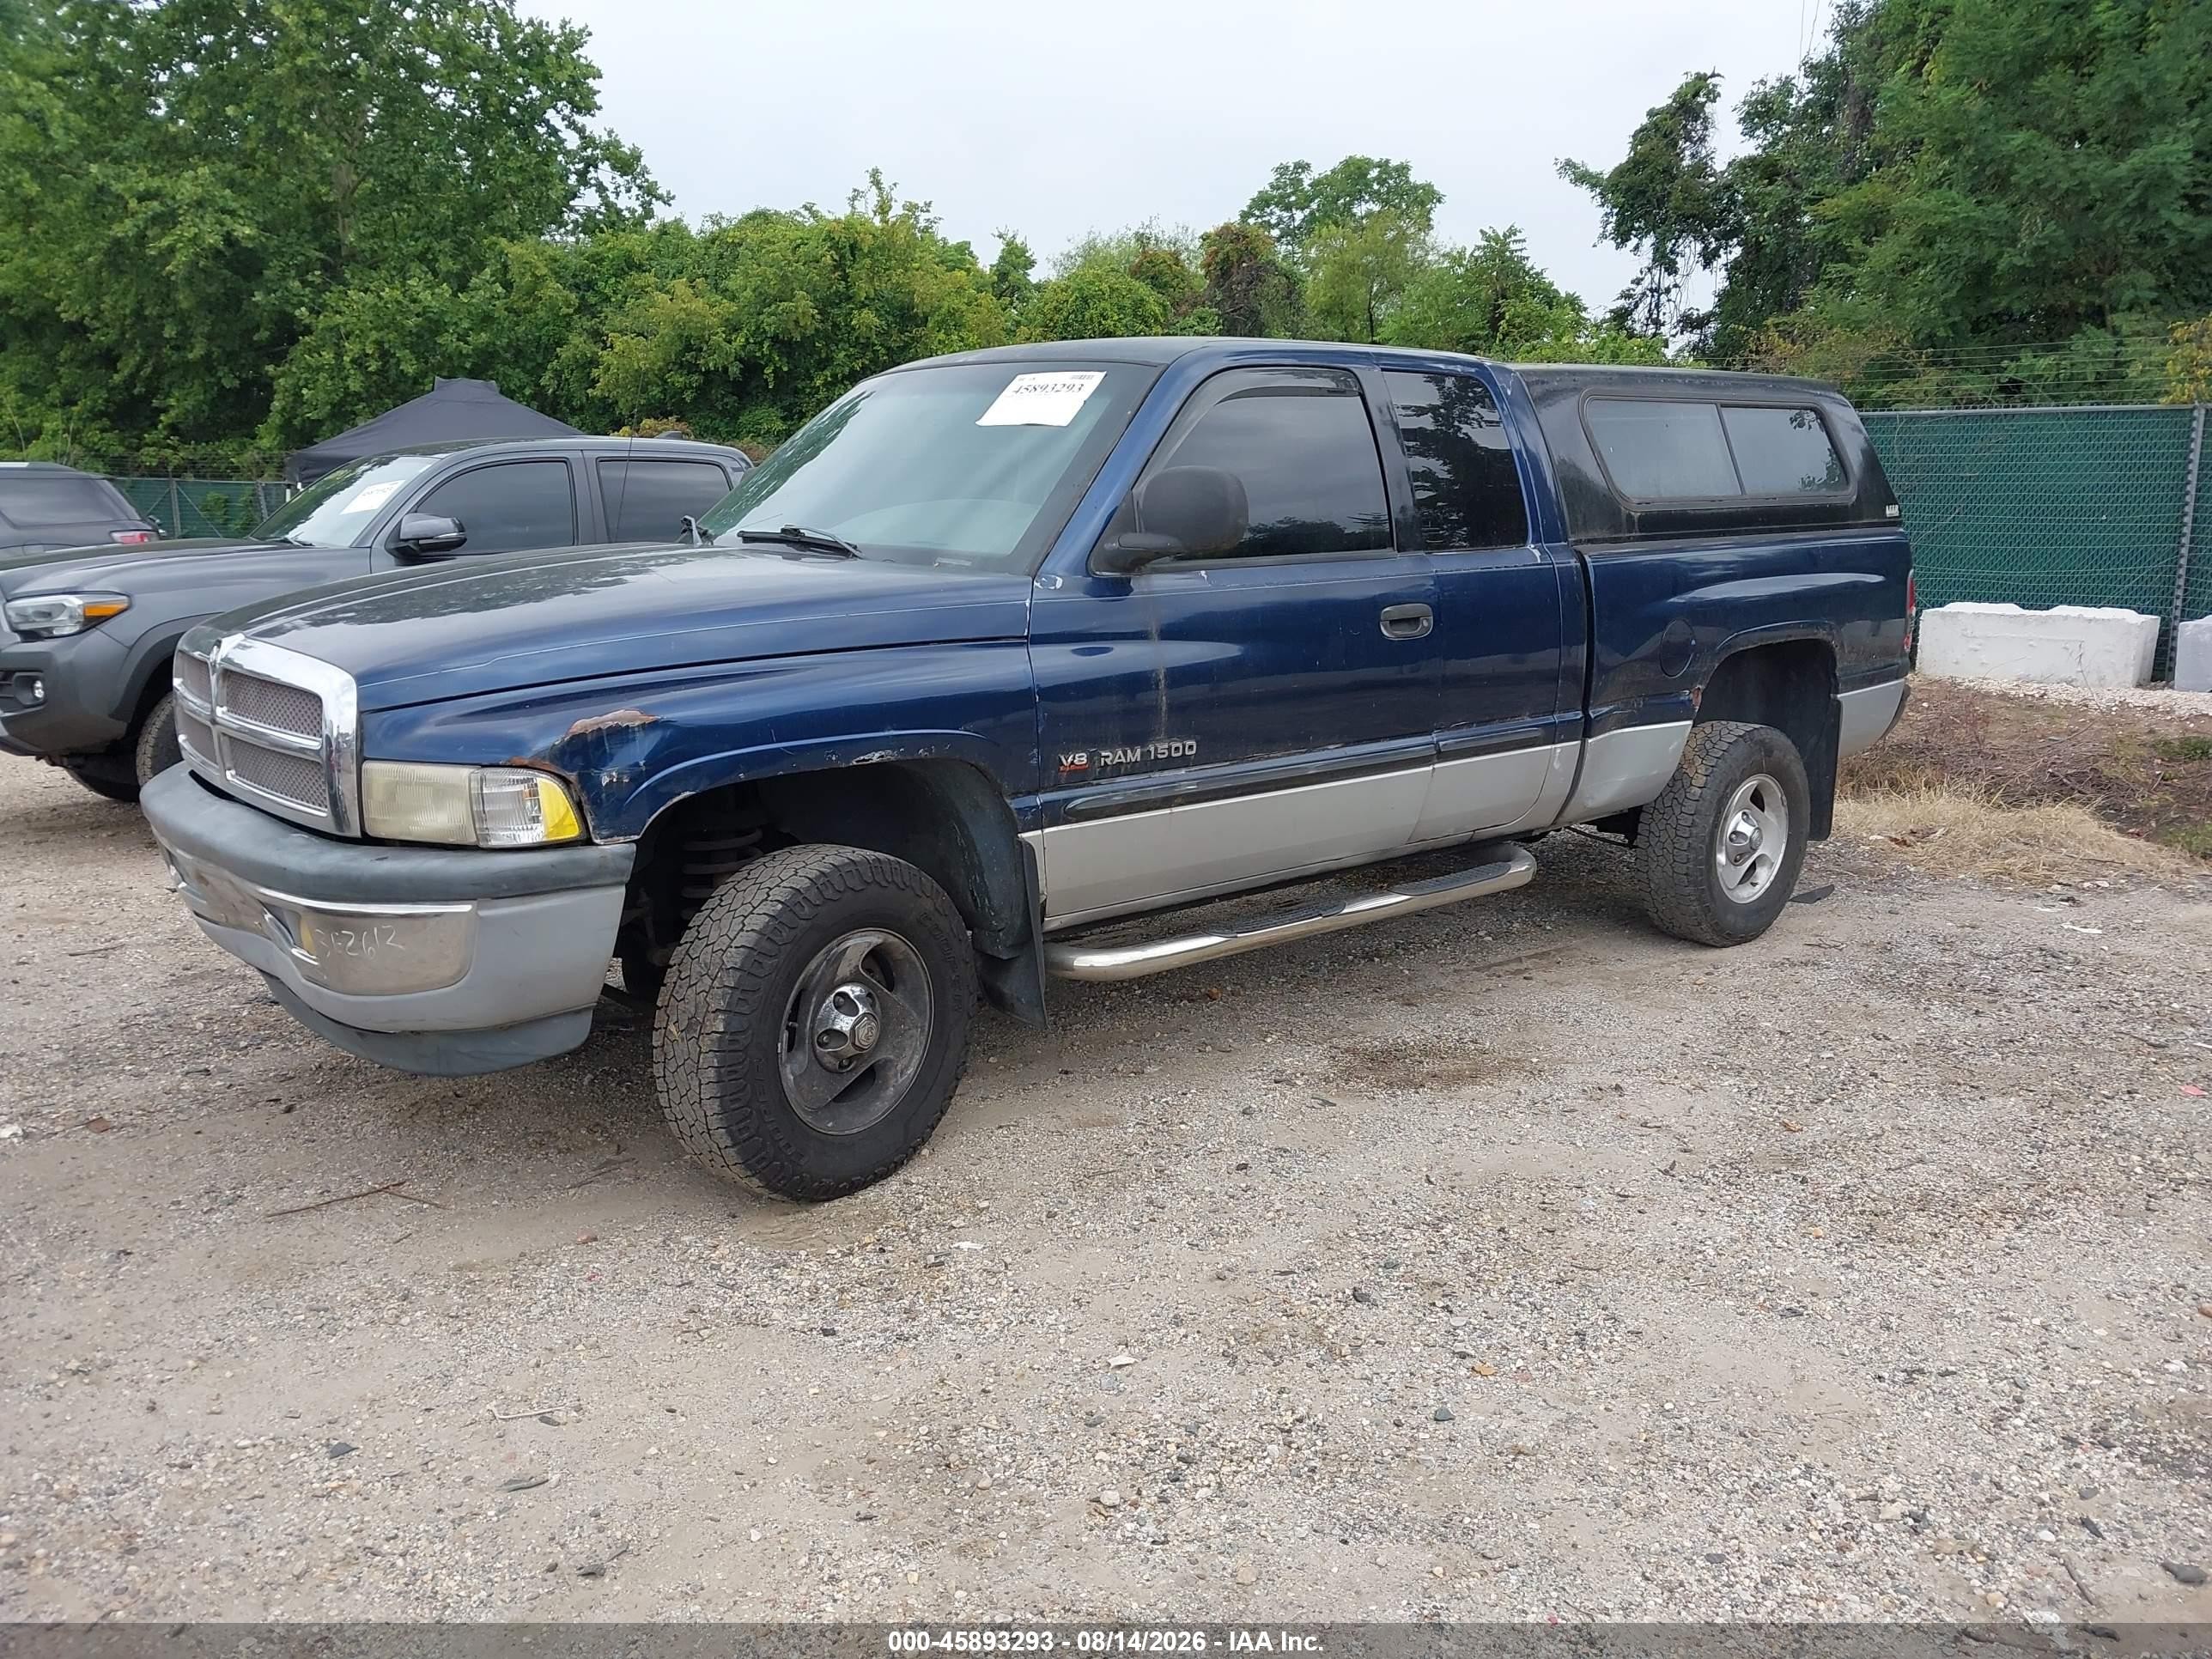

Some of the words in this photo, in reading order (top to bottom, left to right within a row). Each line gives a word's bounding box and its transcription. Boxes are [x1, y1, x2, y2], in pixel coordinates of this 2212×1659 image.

[1012, 382, 1085, 395] 45893293
[1058, 752, 1088, 767] V8
[1100, 746, 1141, 767] RAM
[1147, 741, 1197, 760] 1500
